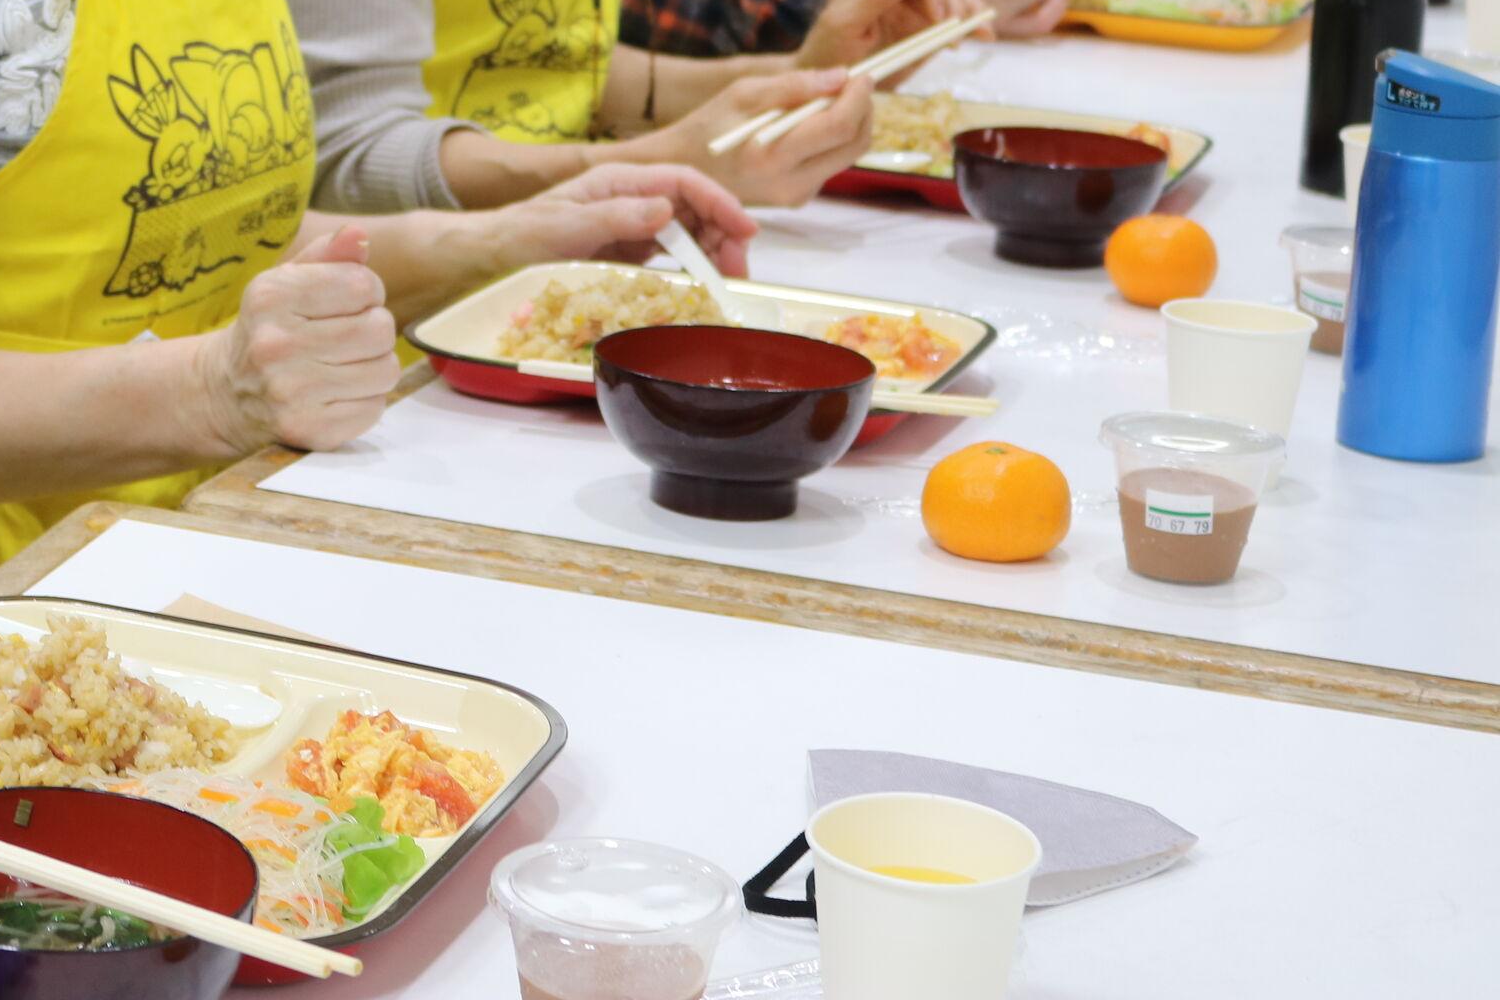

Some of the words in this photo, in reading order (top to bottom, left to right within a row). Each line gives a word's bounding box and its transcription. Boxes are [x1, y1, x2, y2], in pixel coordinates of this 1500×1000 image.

[1148, 513, 1162, 528] 70
[1170, 519, 1185, 532] 67
[1194, 520, 1209, 533] 79
